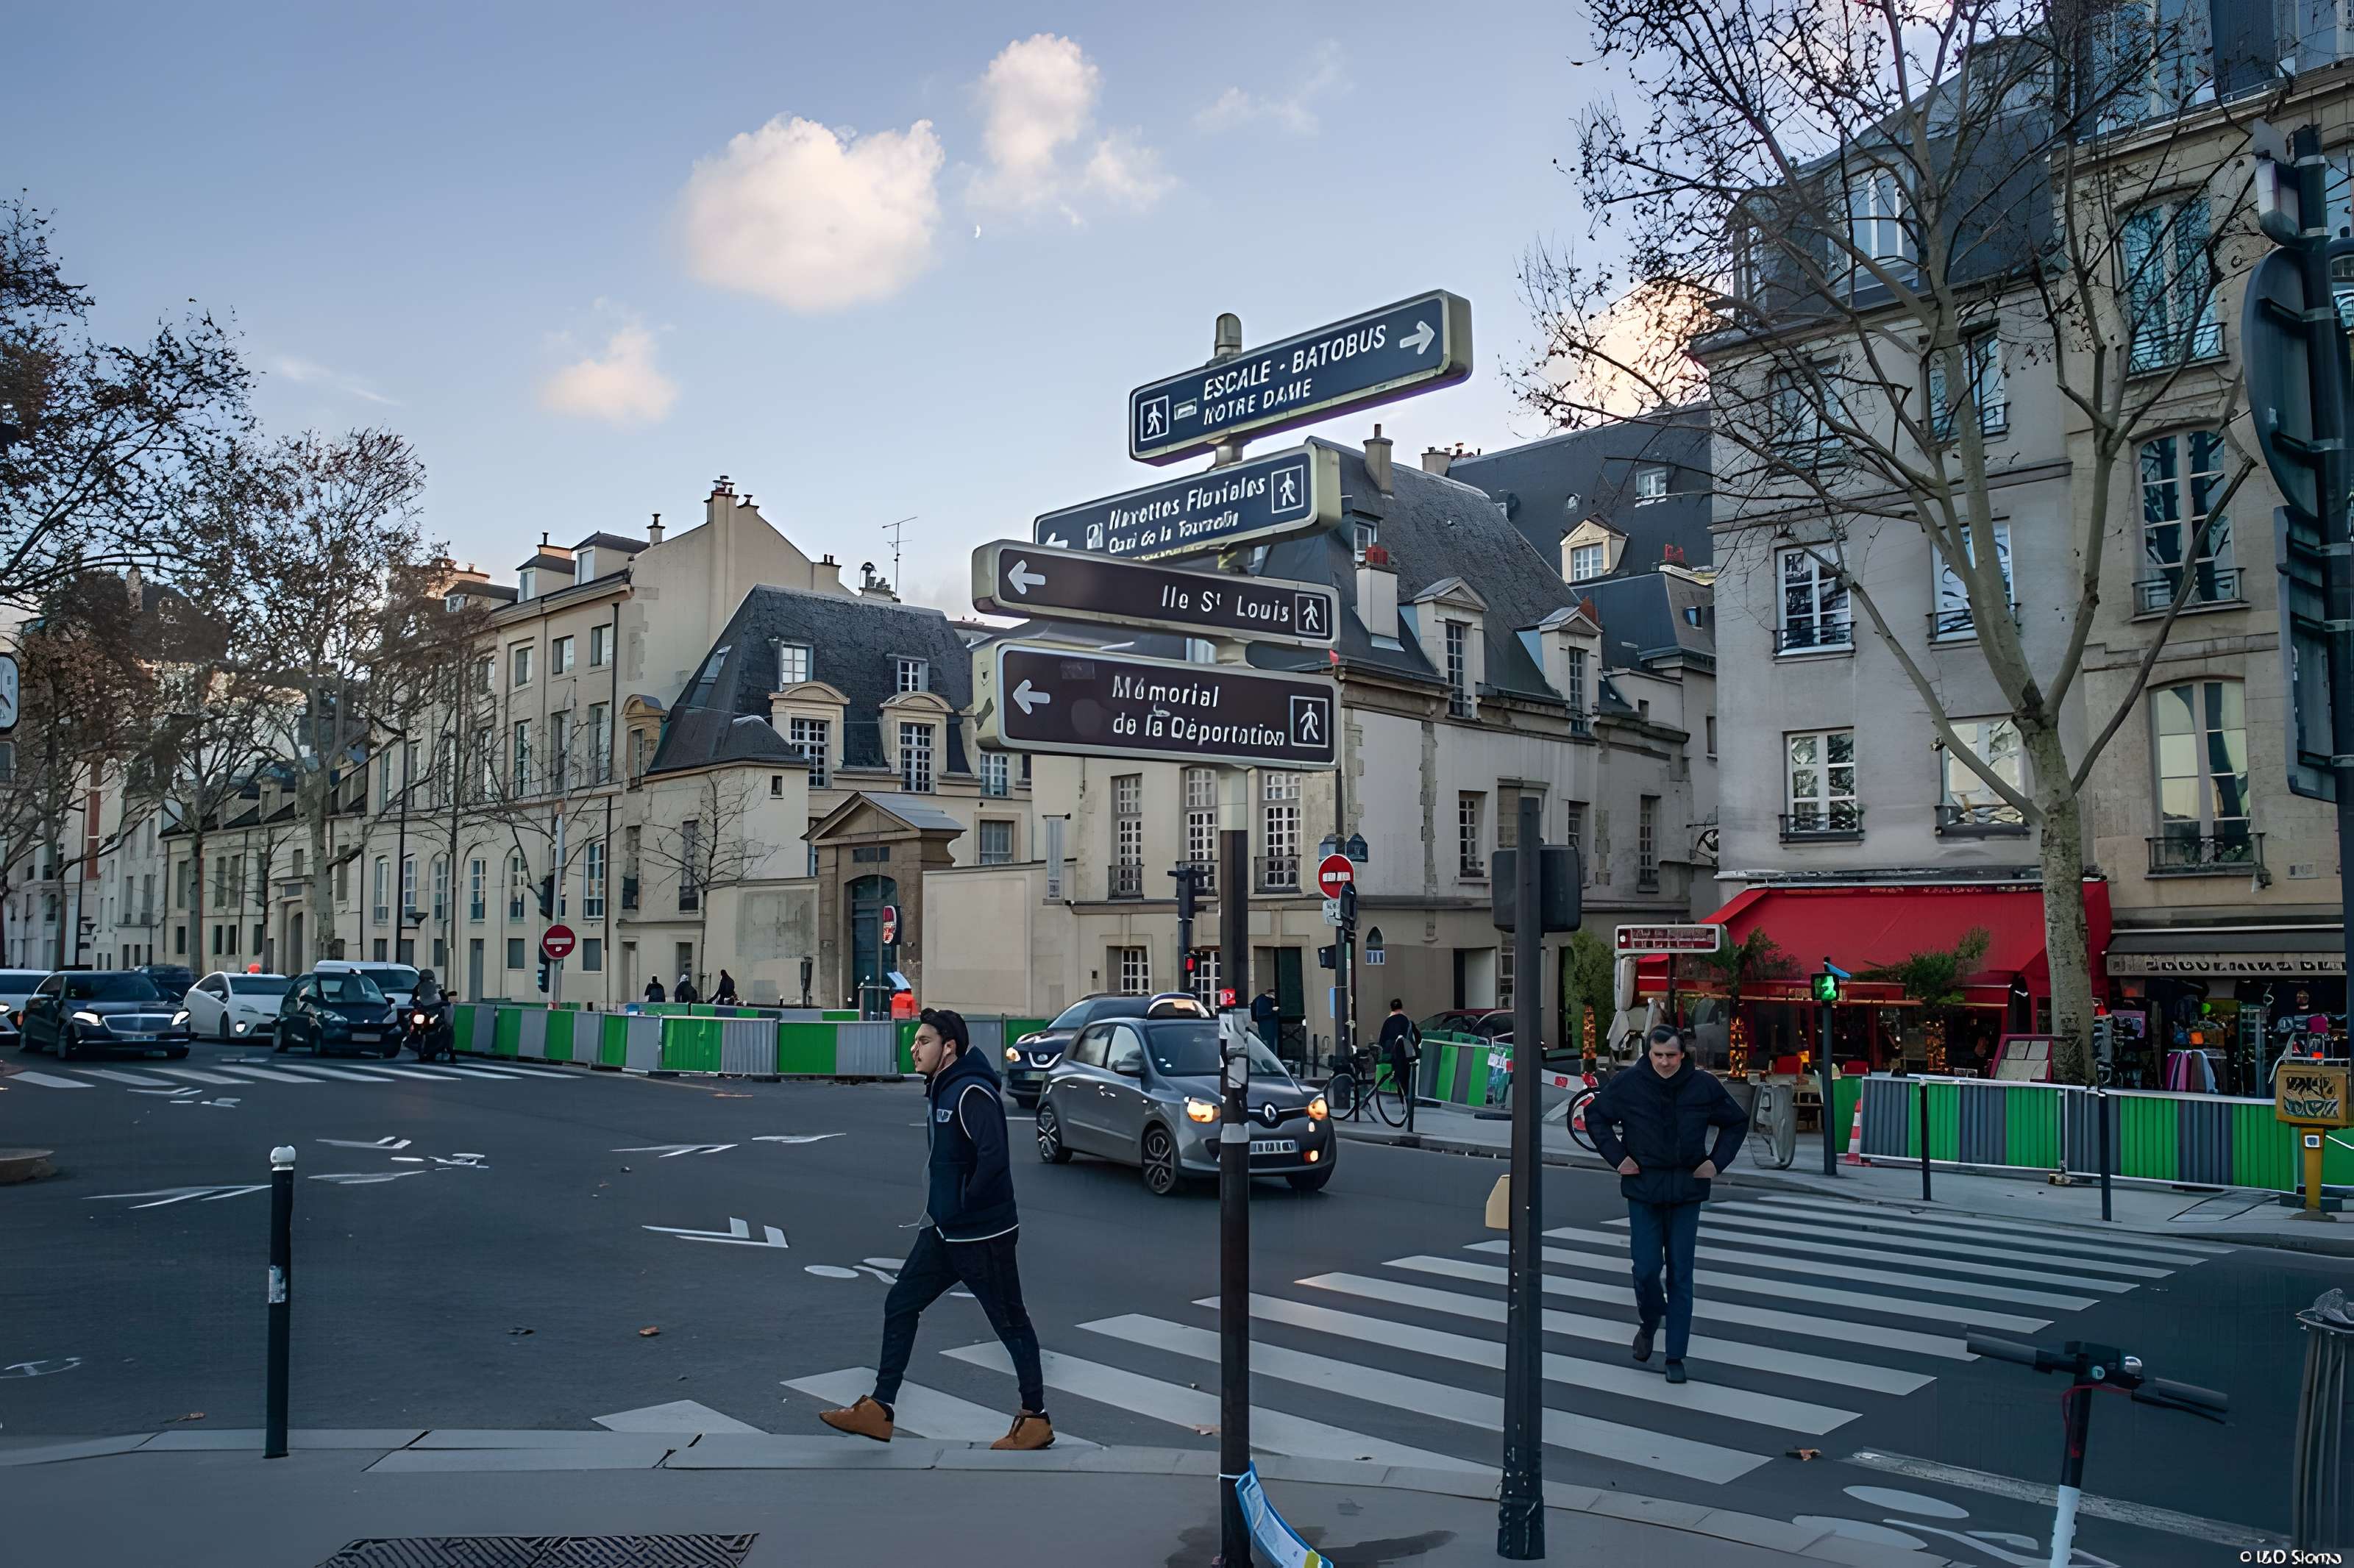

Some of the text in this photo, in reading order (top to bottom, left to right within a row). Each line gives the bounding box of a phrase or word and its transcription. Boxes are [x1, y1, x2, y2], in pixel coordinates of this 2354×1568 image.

[1203, 360, 1271, 401] ESCALE
[1292, 324, 1387, 374] BATOBUS
[1237, 595, 1290, 622] Louis
